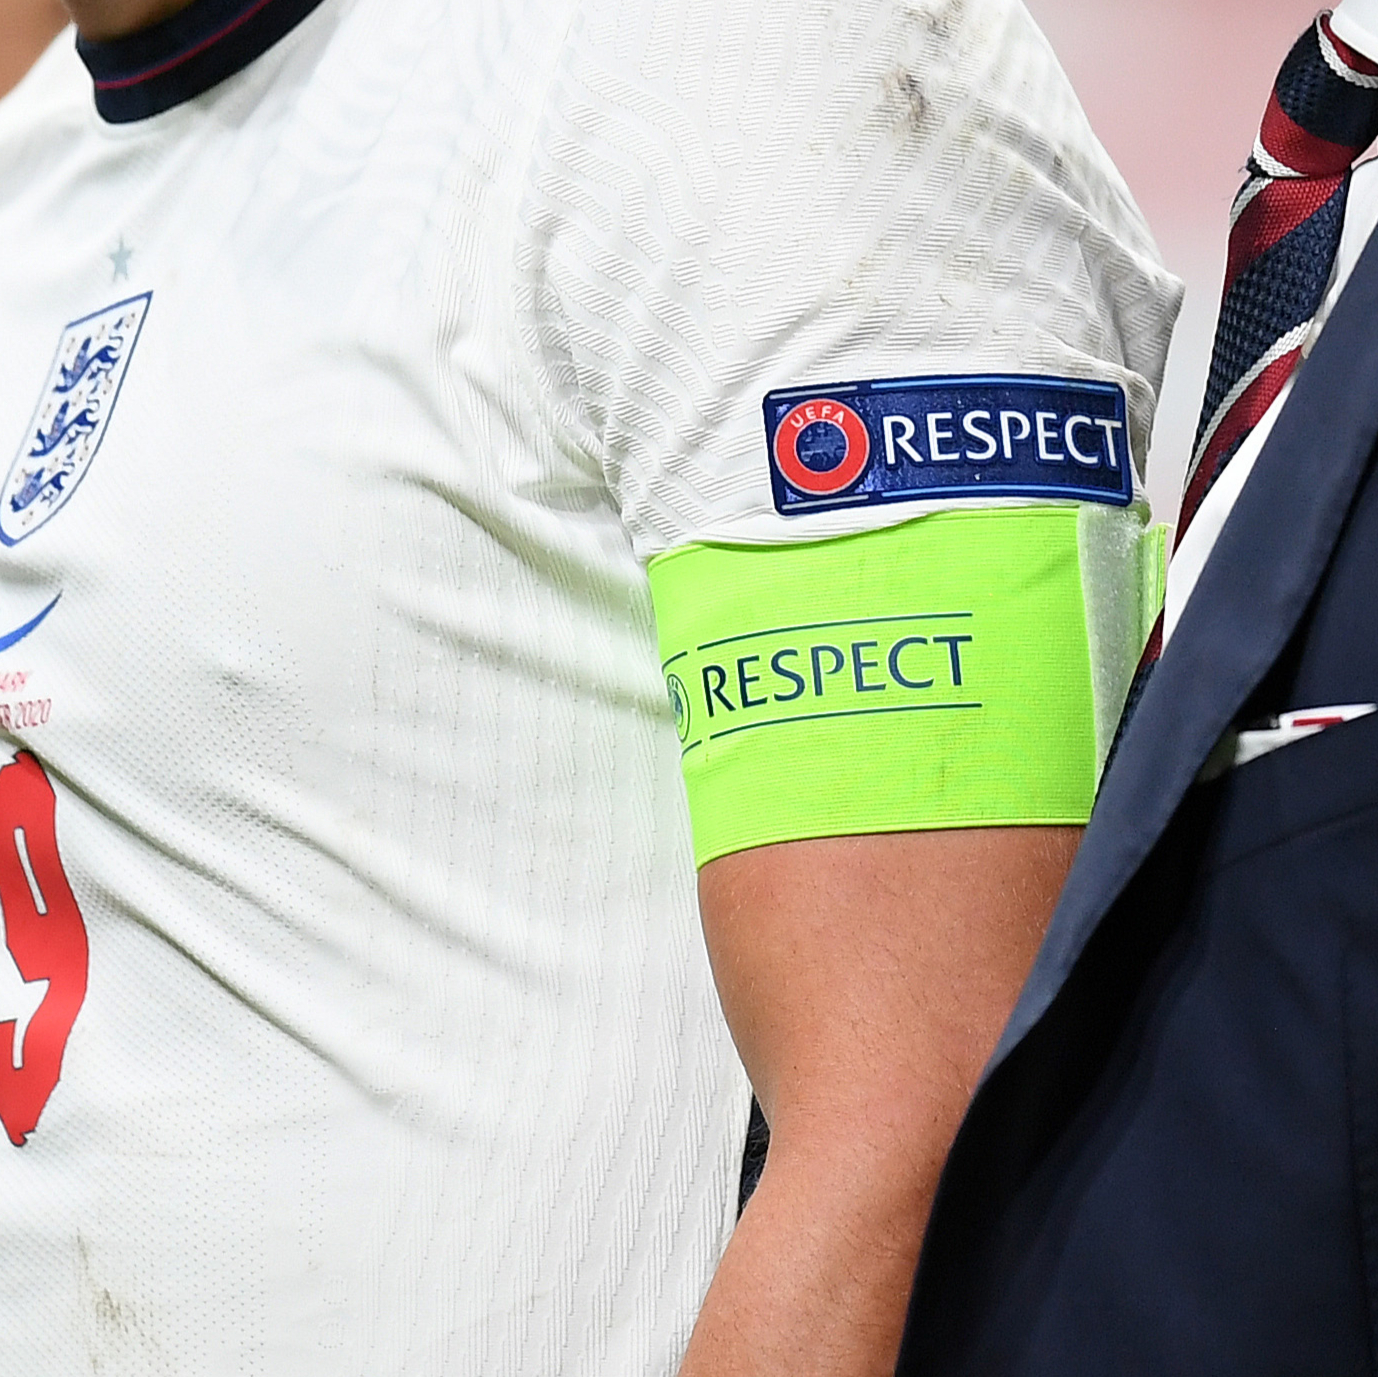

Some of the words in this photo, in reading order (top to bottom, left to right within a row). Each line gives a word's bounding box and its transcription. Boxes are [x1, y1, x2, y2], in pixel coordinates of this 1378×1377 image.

[790, 405, 845, 428] UEFA
[883, 410, 1123, 468] RESPECT
[702, 635, 973, 718] RESPECT
